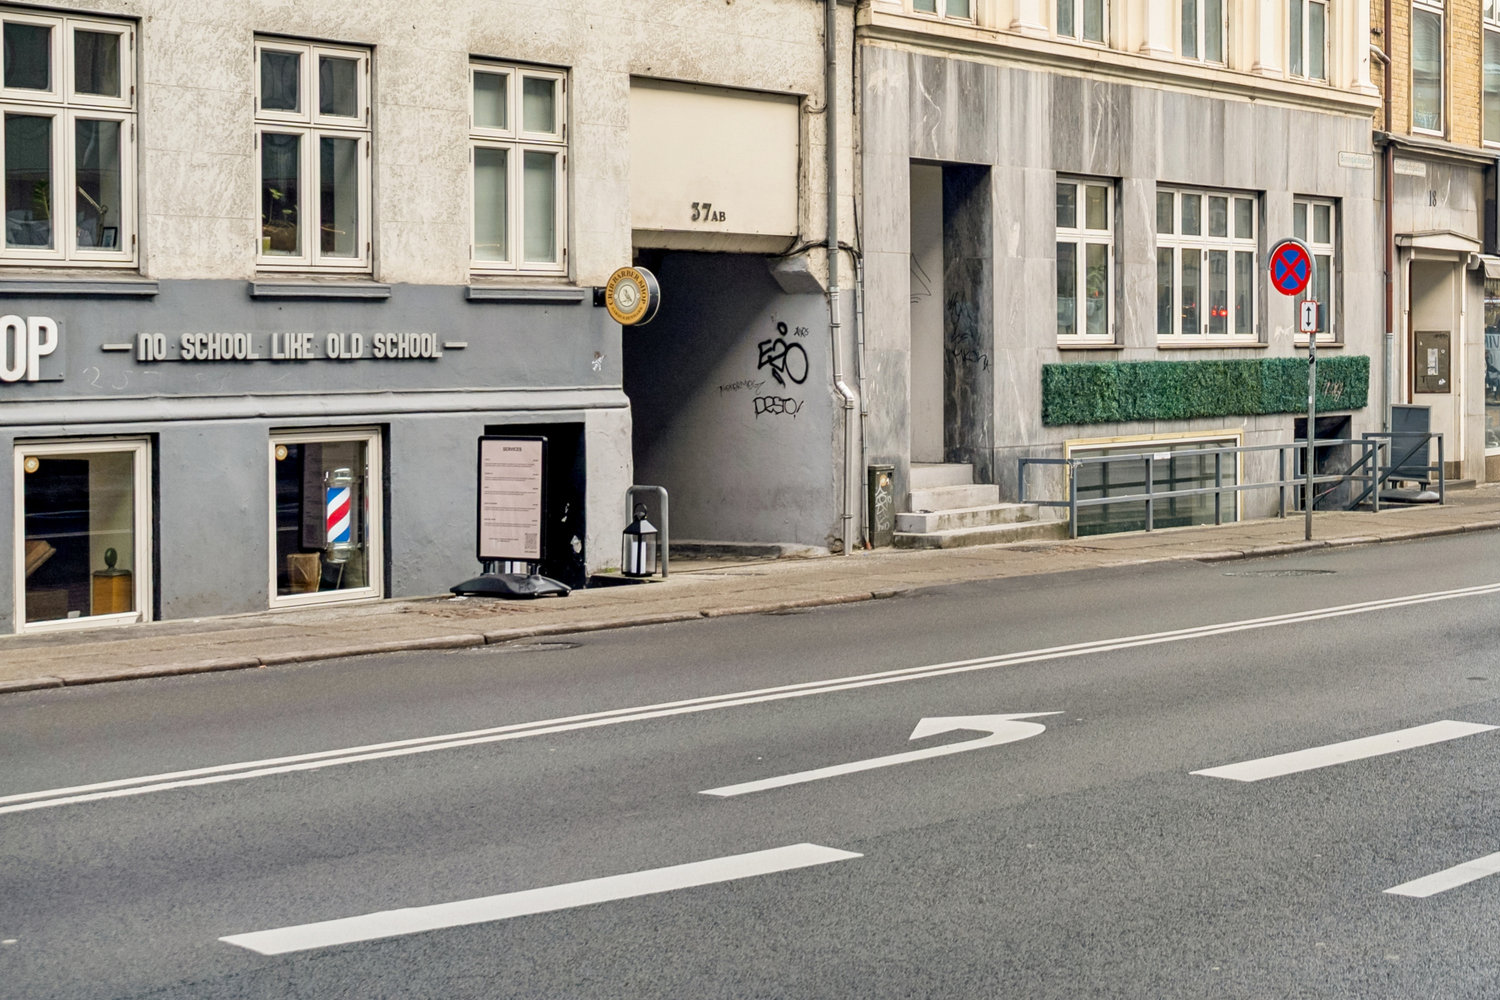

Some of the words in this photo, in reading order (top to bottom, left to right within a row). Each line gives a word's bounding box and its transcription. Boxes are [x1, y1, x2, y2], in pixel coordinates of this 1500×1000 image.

[1429, 190, 1437, 207] 18
[0, 315, 58, 382] OP
[138, 333, 167, 361] NO
[180, 332, 259, 360] SCHOOL
[272, 332, 315, 359] LIKE
[326, 332, 363, 359] OLD
[373, 332, 443, 359] SCHOOL
